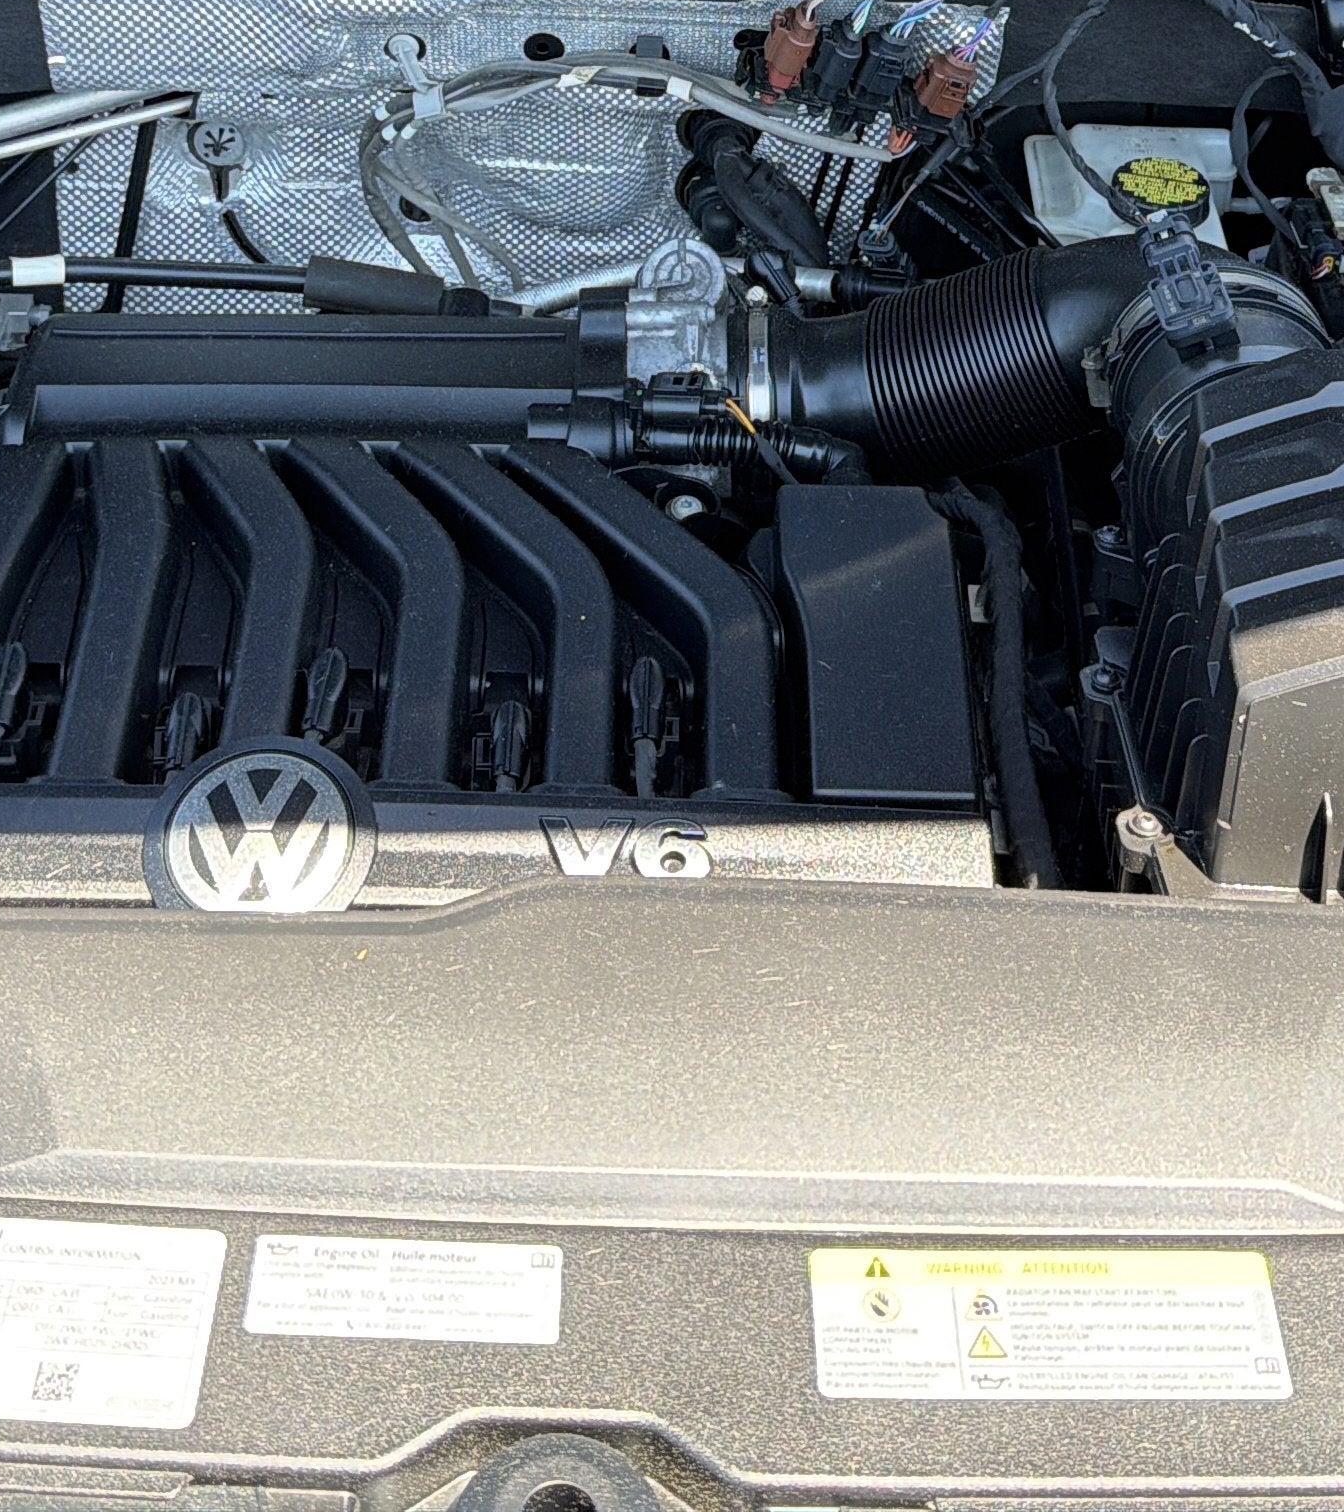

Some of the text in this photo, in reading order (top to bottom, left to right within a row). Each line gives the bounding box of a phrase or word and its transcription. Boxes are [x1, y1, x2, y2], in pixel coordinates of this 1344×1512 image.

[538, 814, 714, 880] V6
[57, 1246, 143, 1262] INFORMATION
[312, 1246, 380, 1261] Engine Oil
[390, 1249, 477, 1263] Huile moteur
[926, 1261, 1109, 1274] WARNING ATTENTION
